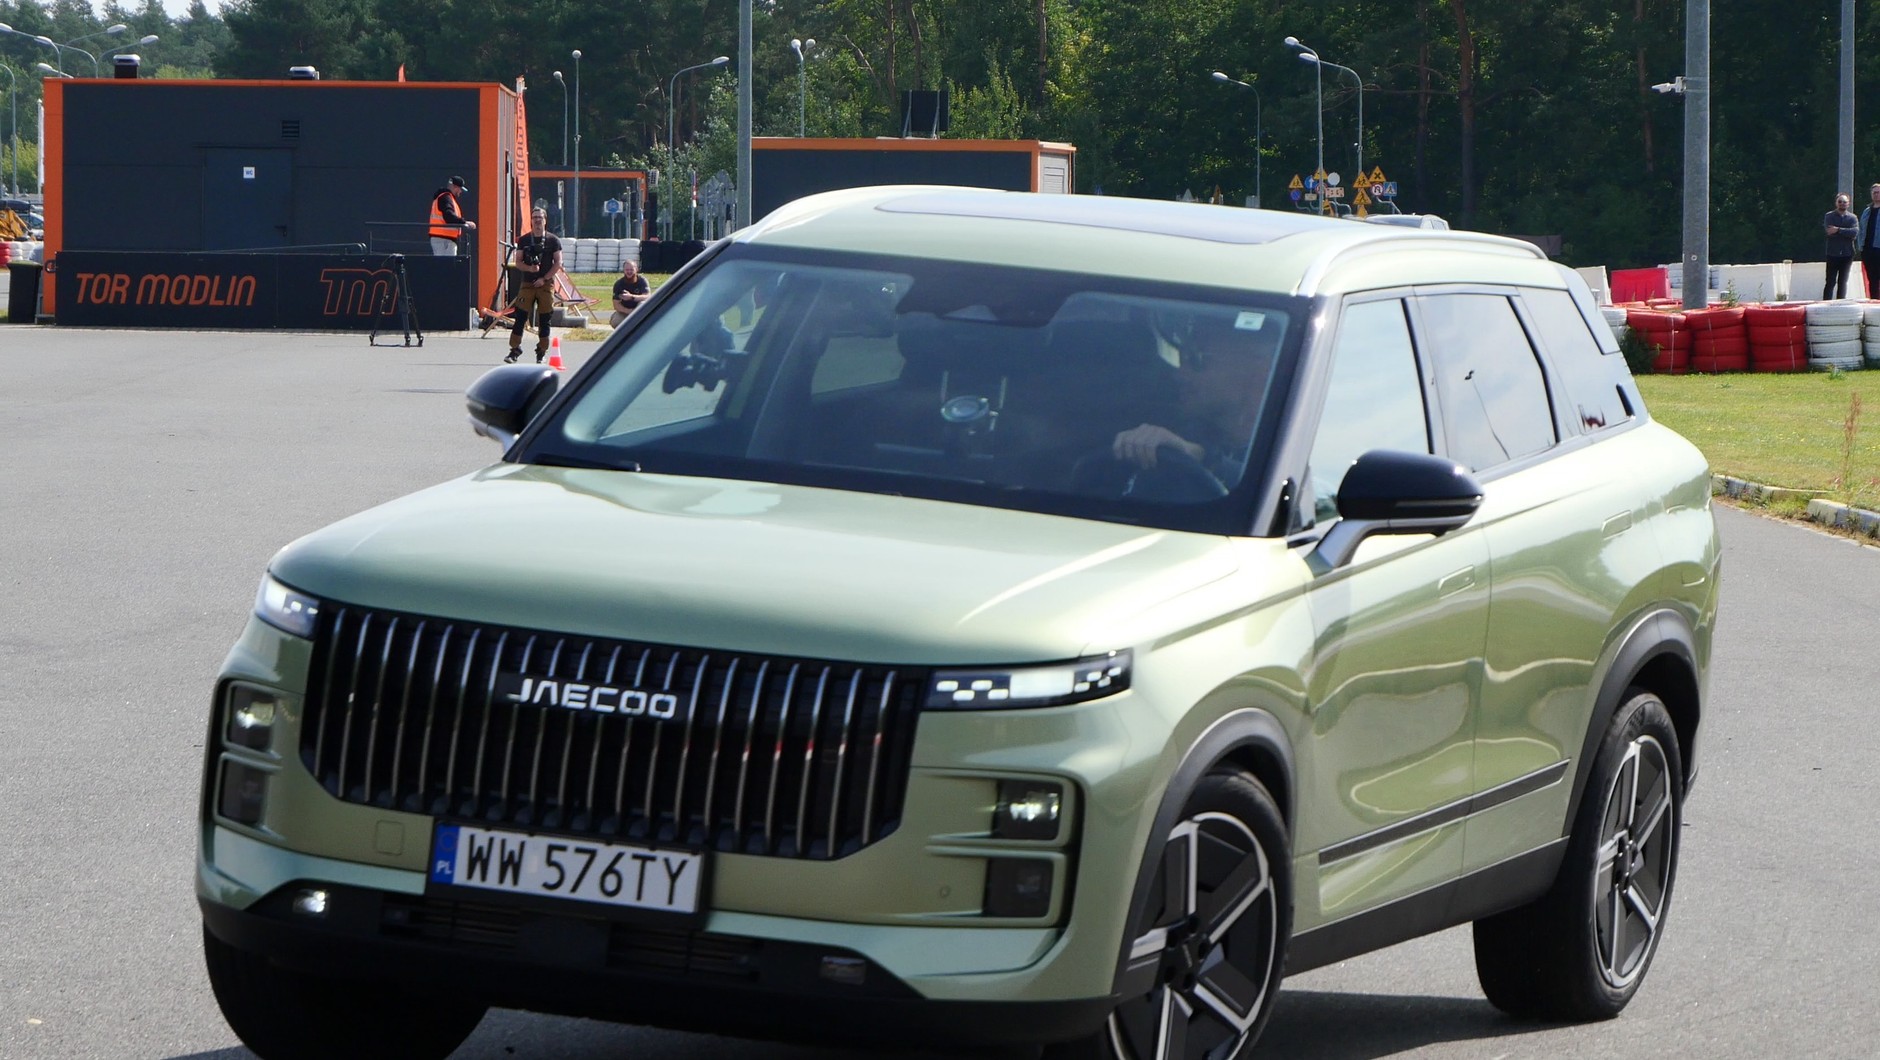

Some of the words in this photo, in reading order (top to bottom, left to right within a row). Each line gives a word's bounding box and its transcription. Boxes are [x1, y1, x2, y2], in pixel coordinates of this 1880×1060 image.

[76, 273, 131, 304] TOR
[135, 274, 257, 306] MODLIN
[507, 678, 677, 719] JAECOO
[435, 860, 452, 875] PL
[466, 833, 526, 887] WW
[541, 843, 688, 906] 576TY
